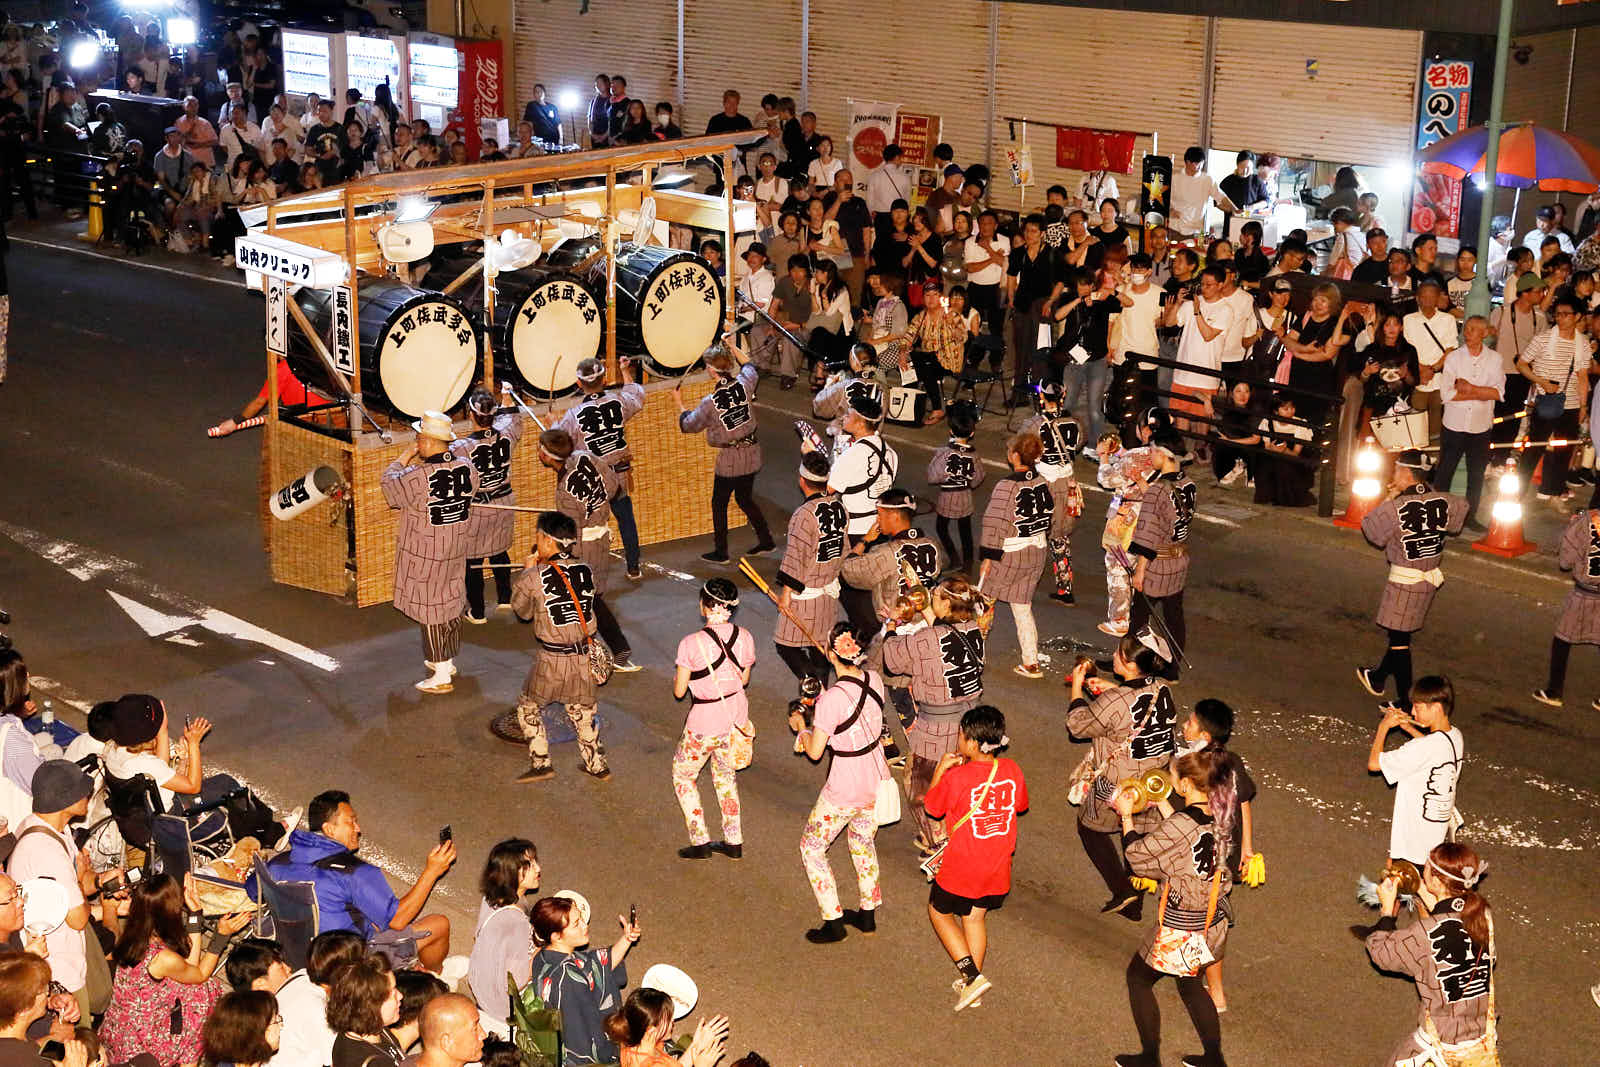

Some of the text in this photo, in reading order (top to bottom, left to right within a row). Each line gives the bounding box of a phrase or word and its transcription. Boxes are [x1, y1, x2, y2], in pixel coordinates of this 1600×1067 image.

[1426, 63, 1471, 90] 名物
[1423, 91, 1457, 148] のへ
[239, 245, 310, 280] 山内クリニック
